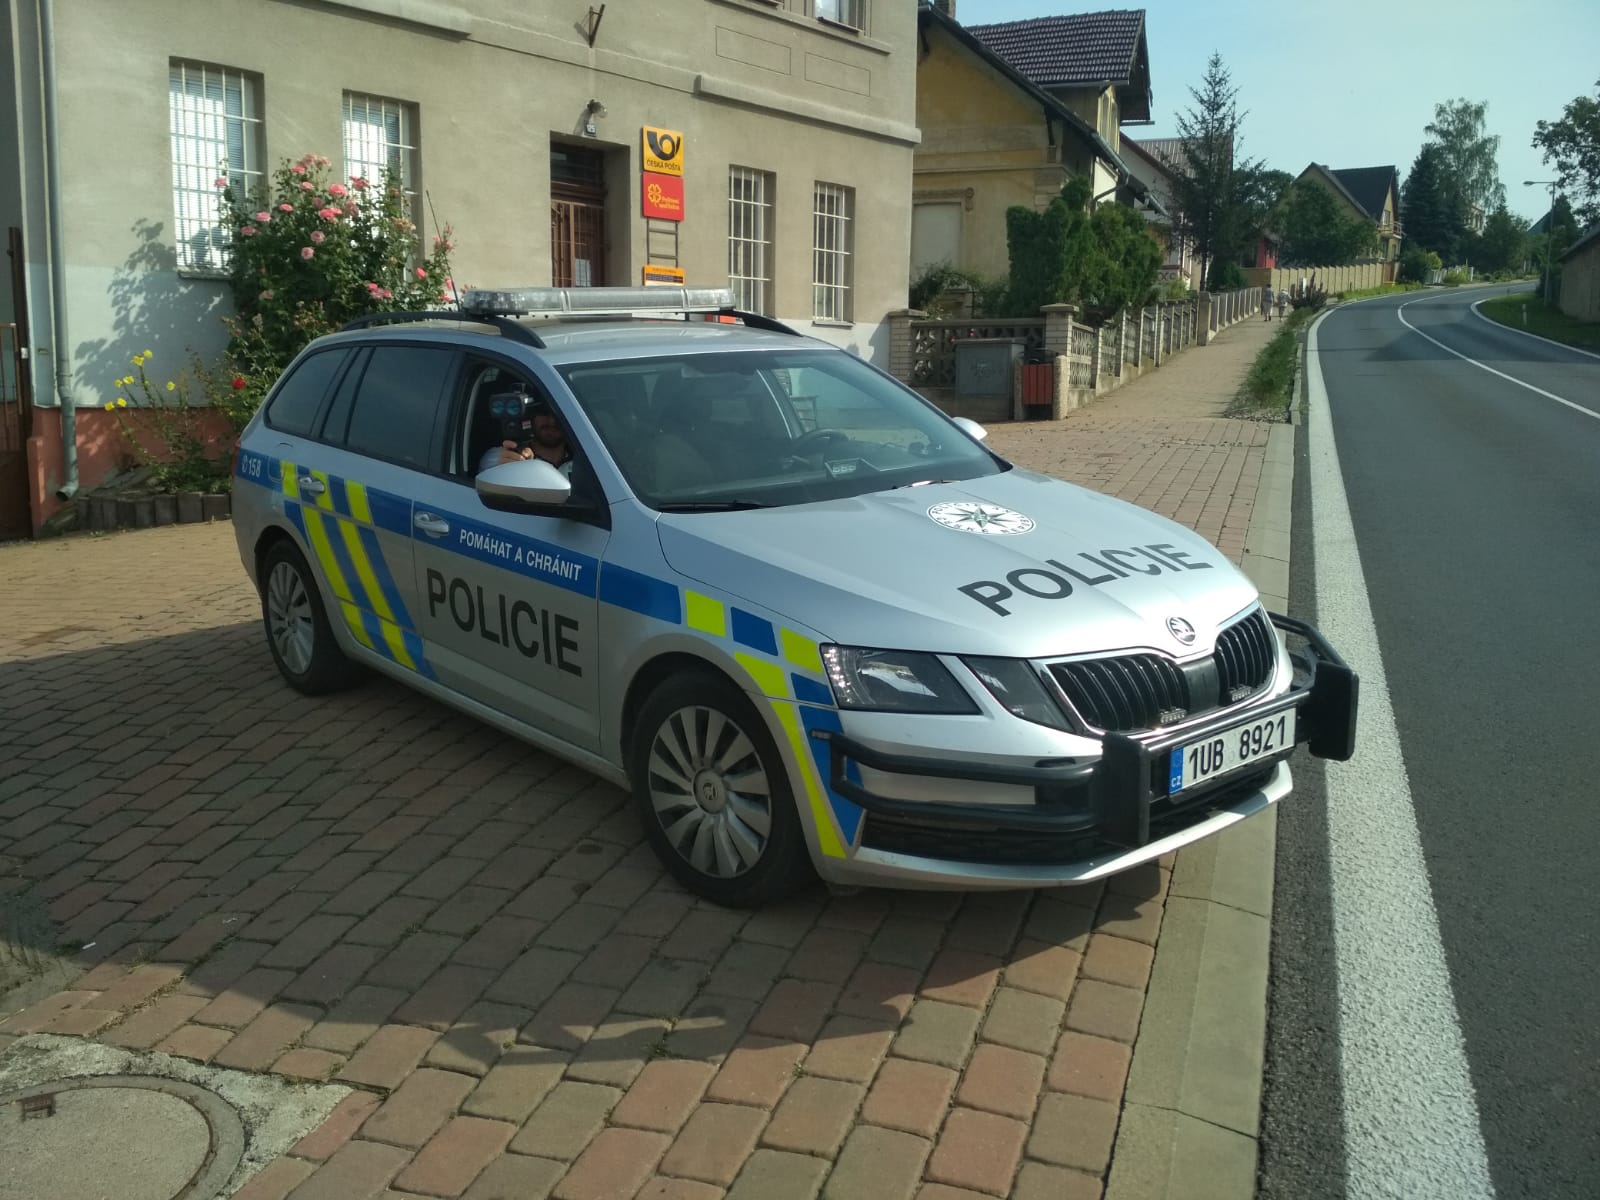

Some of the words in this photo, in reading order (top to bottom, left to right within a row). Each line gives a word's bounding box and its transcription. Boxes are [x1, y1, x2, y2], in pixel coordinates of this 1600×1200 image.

[249, 457, 261, 478] 158
[459, 528, 513, 559] POMÁHAT
[514, 546, 523, 564] A
[526, 550, 582, 581] CHRÁNIT
[956, 543, 1214, 617] POLICIE
[426, 567, 583, 678] POLICIE
[1189, 738, 1225, 780] 1UB
[1239, 715, 1286, 760] 8921
[1171, 775, 1182, 788] CZ
